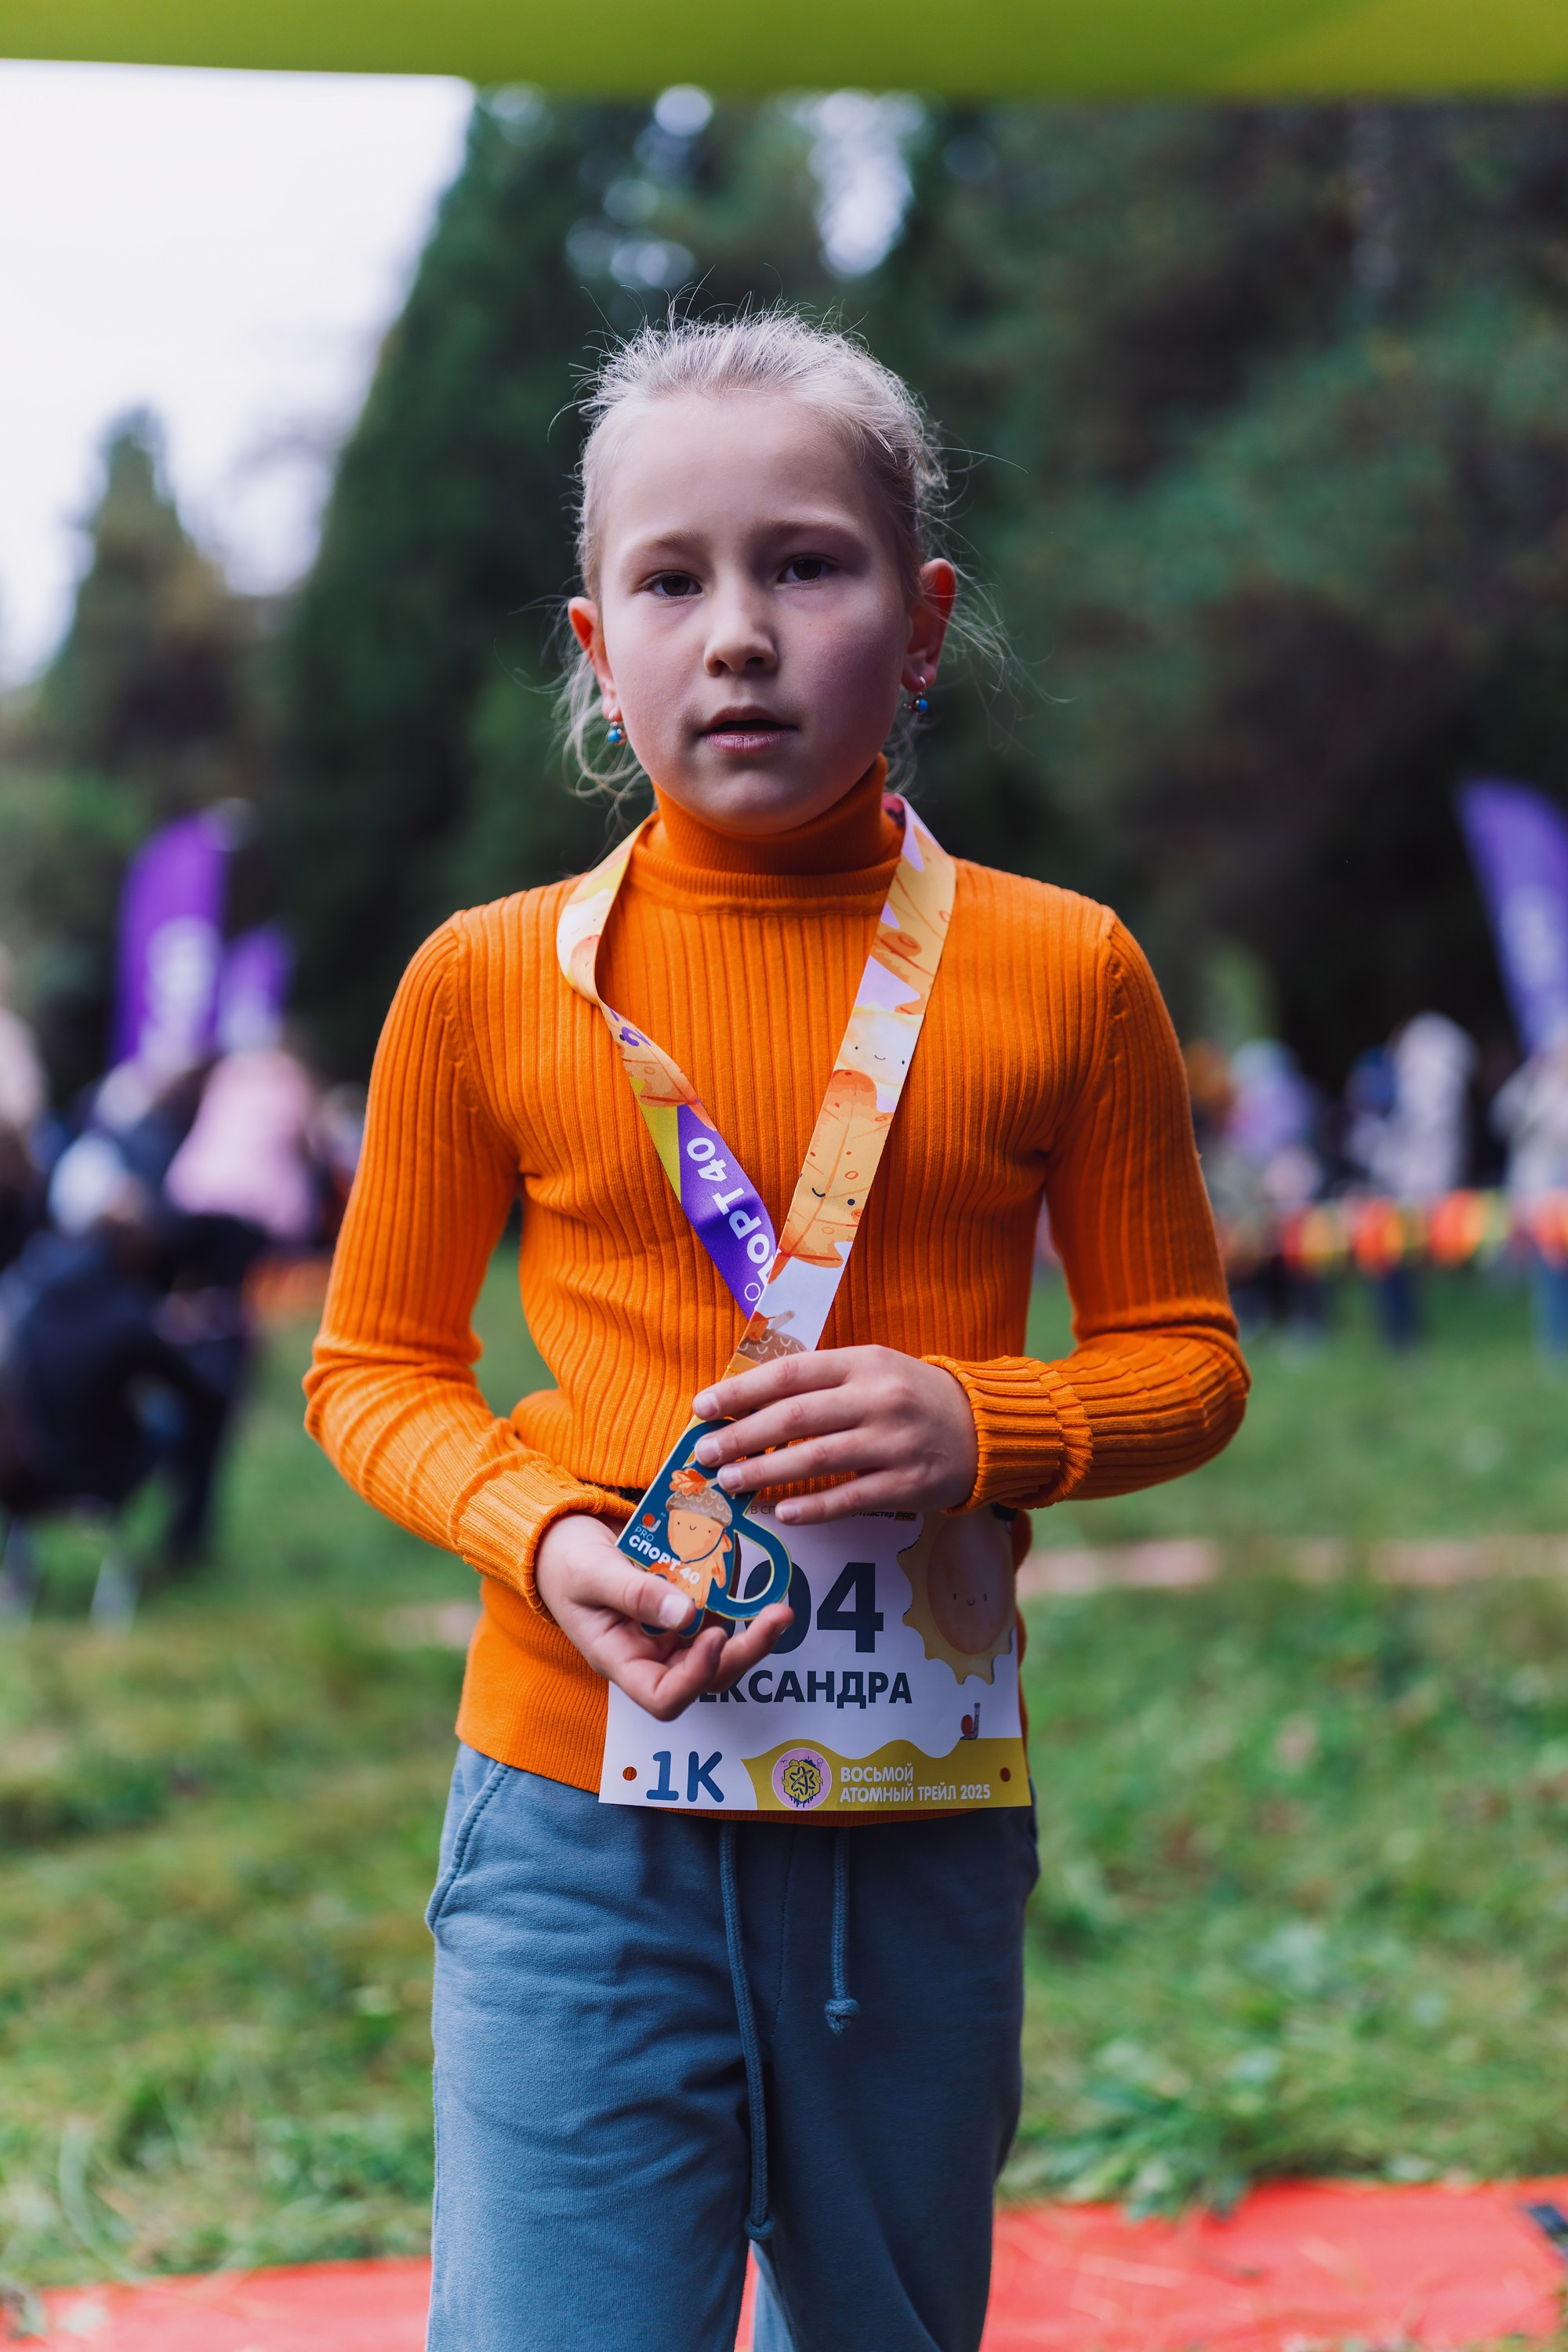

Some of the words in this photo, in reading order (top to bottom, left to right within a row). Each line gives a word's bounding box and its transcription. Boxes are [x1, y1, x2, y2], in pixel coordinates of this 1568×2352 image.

[686, 1137, 727, 1181] 40
[634, 1526, 654, 1542] PRO
[629, 1535, 681, 1572] СПОРТ
[680, 1566, 701, 1584] 40
[723, 1559, 884, 1654] 04
[840, 1763, 913, 1782] ВОСЬМОЙ
[840, 1782, 913, 1802] АТОМНЫЙ
[917, 1782, 956, 1801] ТРЕЙЛ
[960, 1784, 991, 1800] 2025
